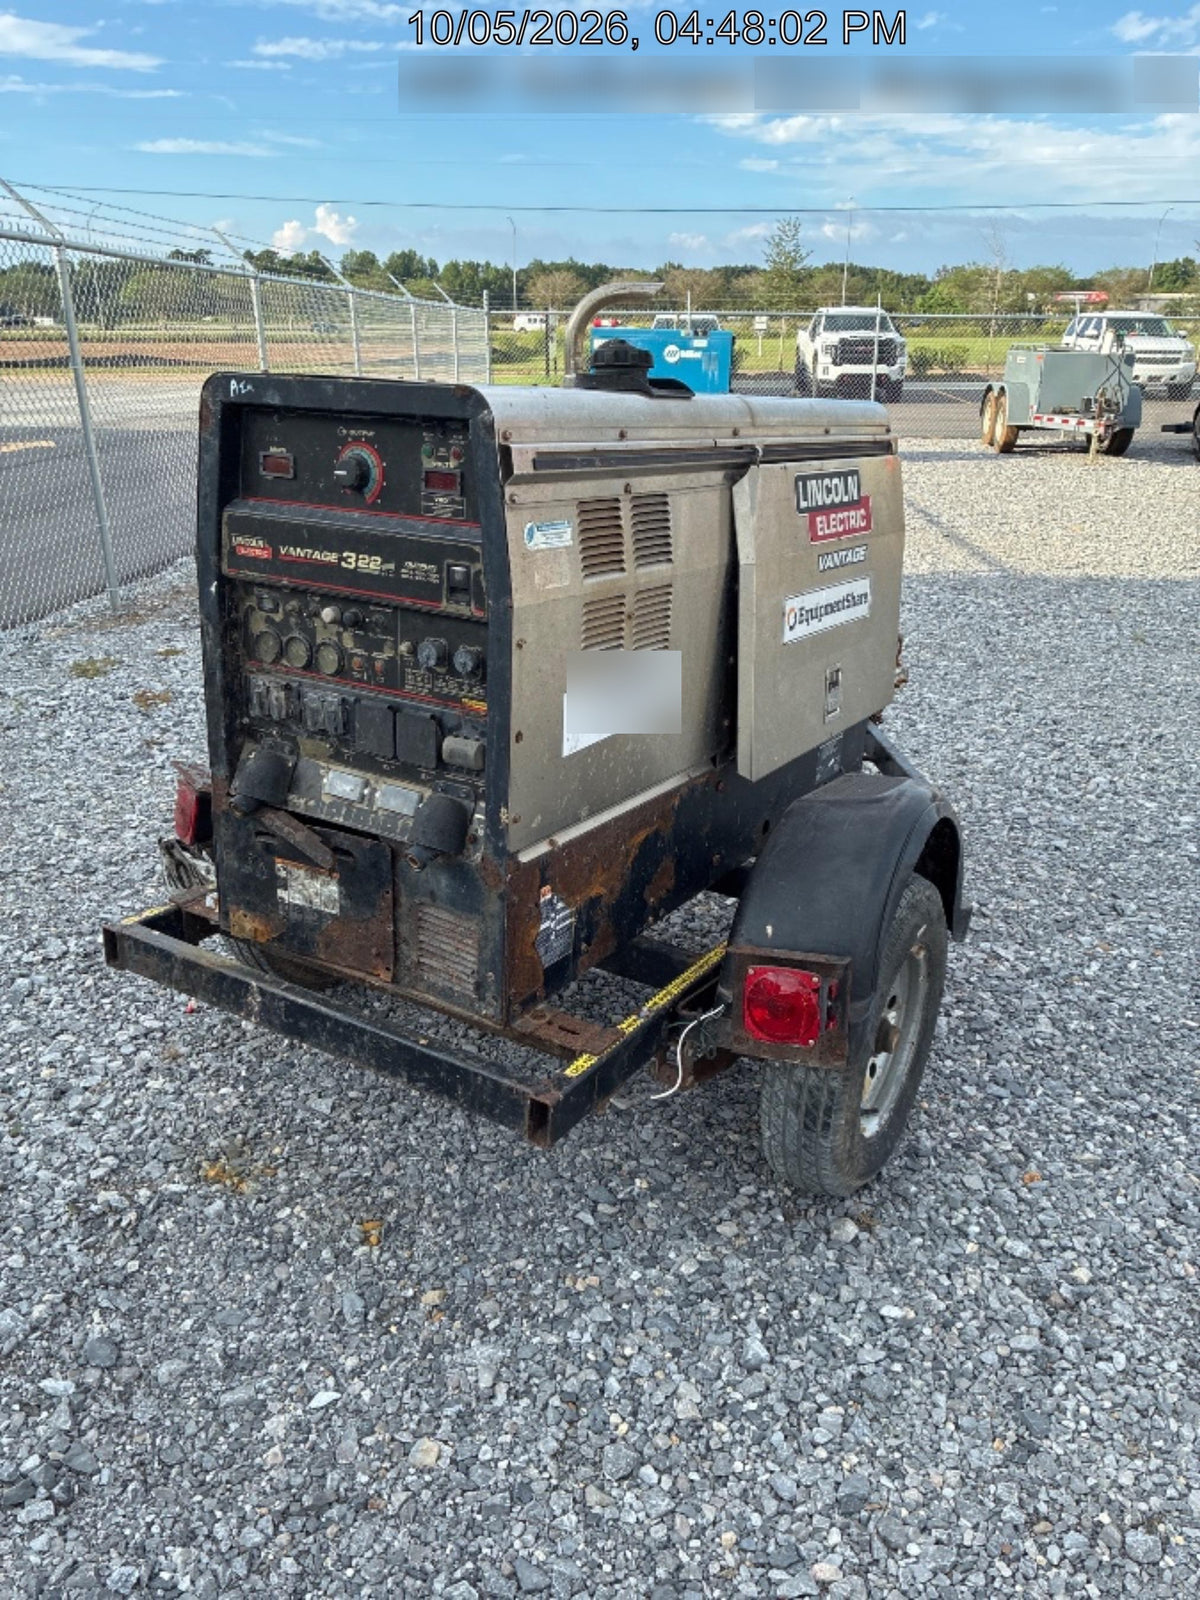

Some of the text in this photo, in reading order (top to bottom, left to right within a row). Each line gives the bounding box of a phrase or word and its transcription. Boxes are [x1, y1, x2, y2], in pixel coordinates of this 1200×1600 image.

[798, 475, 859, 509] LINCOLN
[815, 508, 867, 536] ELECTRIC
[279, 545, 339, 563] VANTAGE
[340, 551, 382, 570] 322
[818, 544, 868, 572] VANTAGE
[798, 592, 868, 626] EquipmentShare
